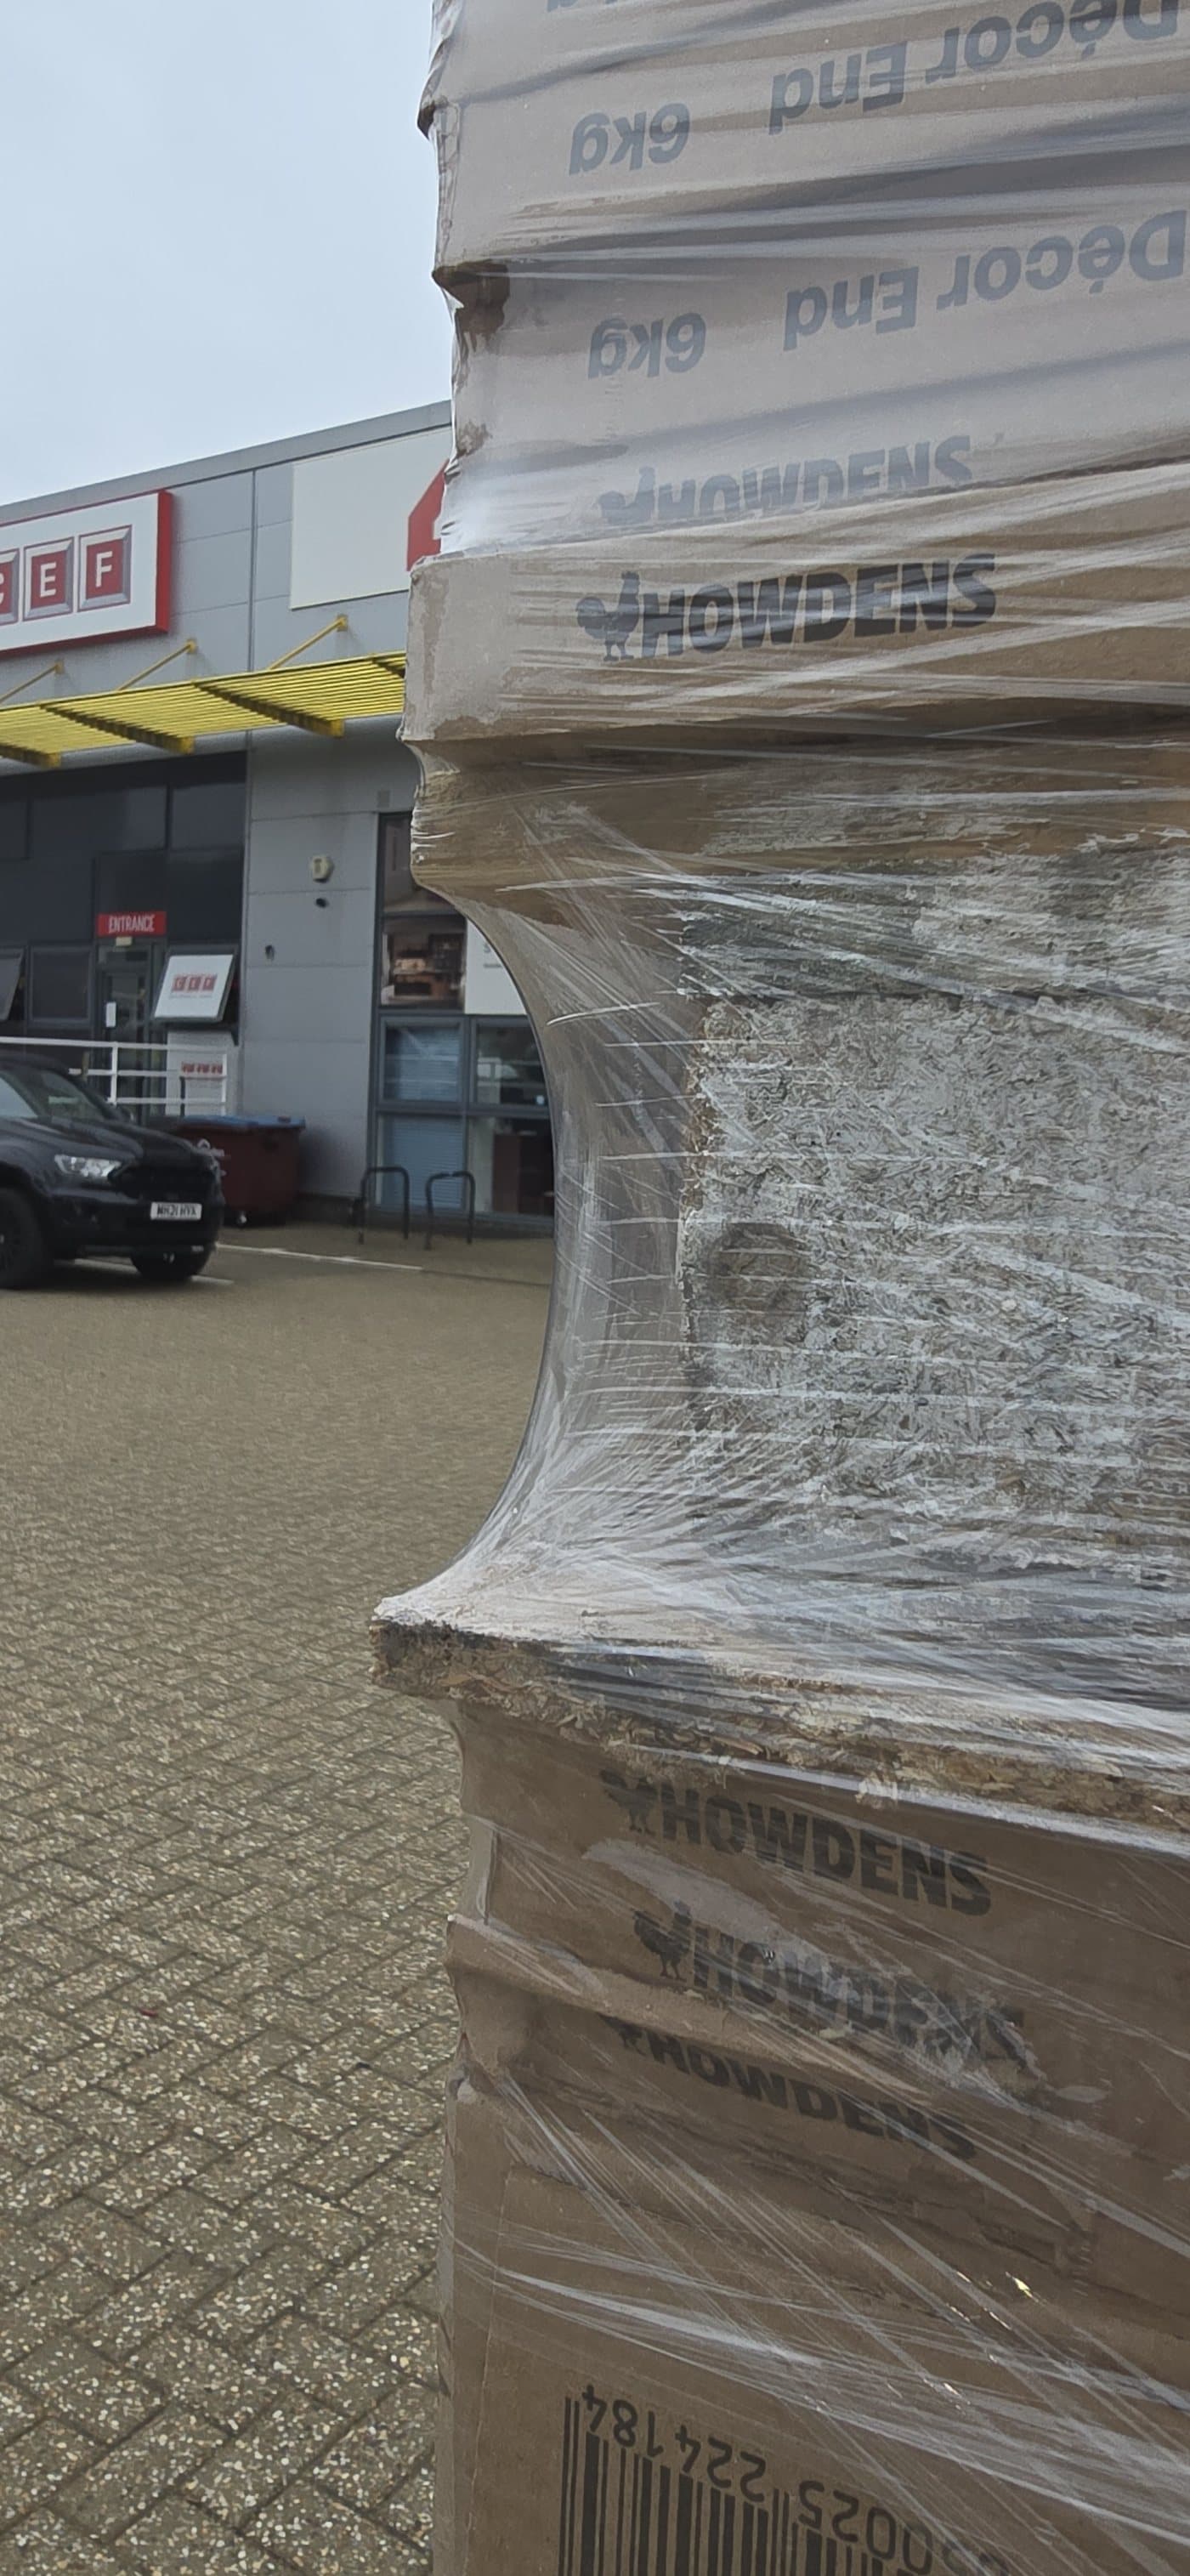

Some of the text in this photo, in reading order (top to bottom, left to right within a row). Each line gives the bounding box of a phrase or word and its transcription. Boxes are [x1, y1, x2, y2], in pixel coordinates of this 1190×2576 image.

[569, 0, 1179, 175] Décor End 6kg
[587, 210, 1188, 379] Décor End 6kg
[654, 435, 973, 518] HOWDENS
[641, 553, 997, 659] HOWDENS
[109, 914, 156, 933] ENTRANCE
[660, 1780, 992, 1915] HOWDENS
[693, 1926, 1034, 2071] HOWD
[582, 2384, 766, 2502] 224184
